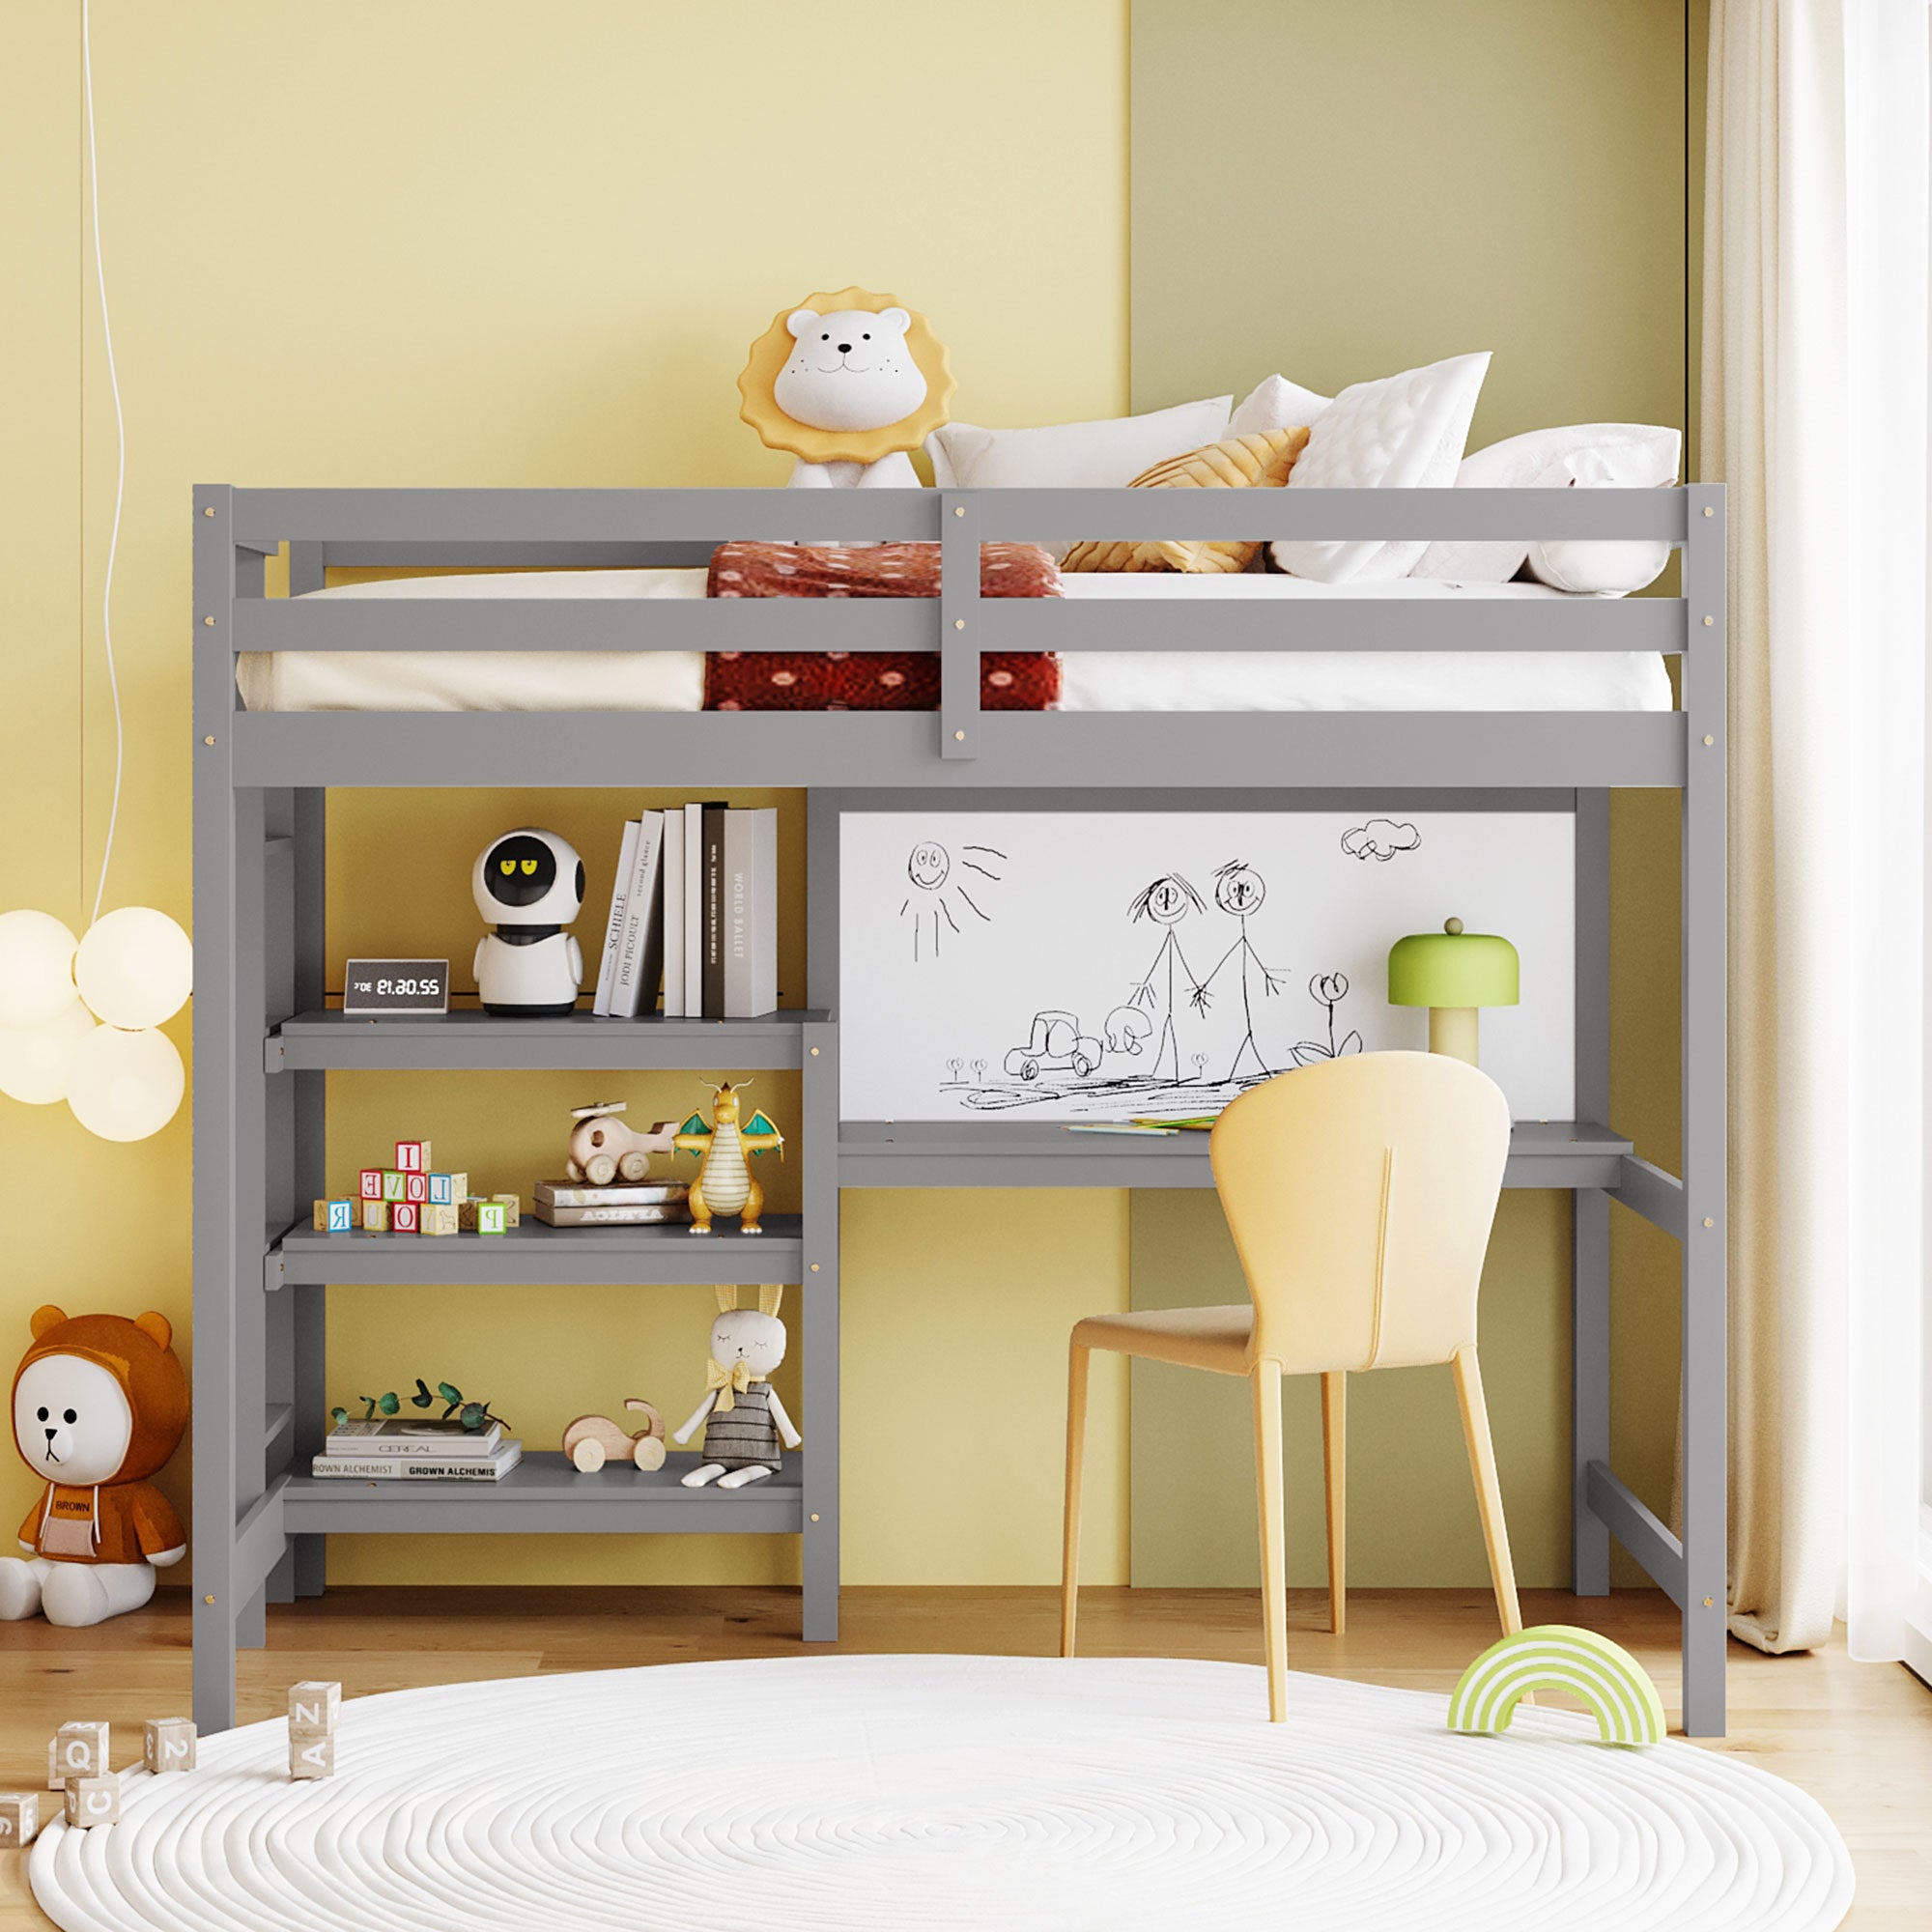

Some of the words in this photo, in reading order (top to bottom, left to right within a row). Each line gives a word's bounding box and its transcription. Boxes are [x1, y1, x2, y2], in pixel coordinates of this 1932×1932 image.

[640, 839, 651, 867] glance
[637, 868, 646, 897] second
[733, 872, 744, 915] WORLD
[608, 894, 627, 950] SCHIELE
[625, 915, 639, 959] PICOULT
[733, 919, 744, 958] BALLET
[619, 960, 633, 986] JODI
[313, 1463, 341, 1473] ROWN
[343, 1463, 392, 1474] ALCHEMIST
[409, 1466, 444, 1475] GROWN
[446, 1466, 497, 1477] ALCHEMIS
[55, 1500, 90, 1513] BROWN
[66, 1741, 92, 1771] Q
[164, 1740, 188, 1760] 2
[300, 1742, 327, 1767] A
[86, 1790, 112, 1815] C
